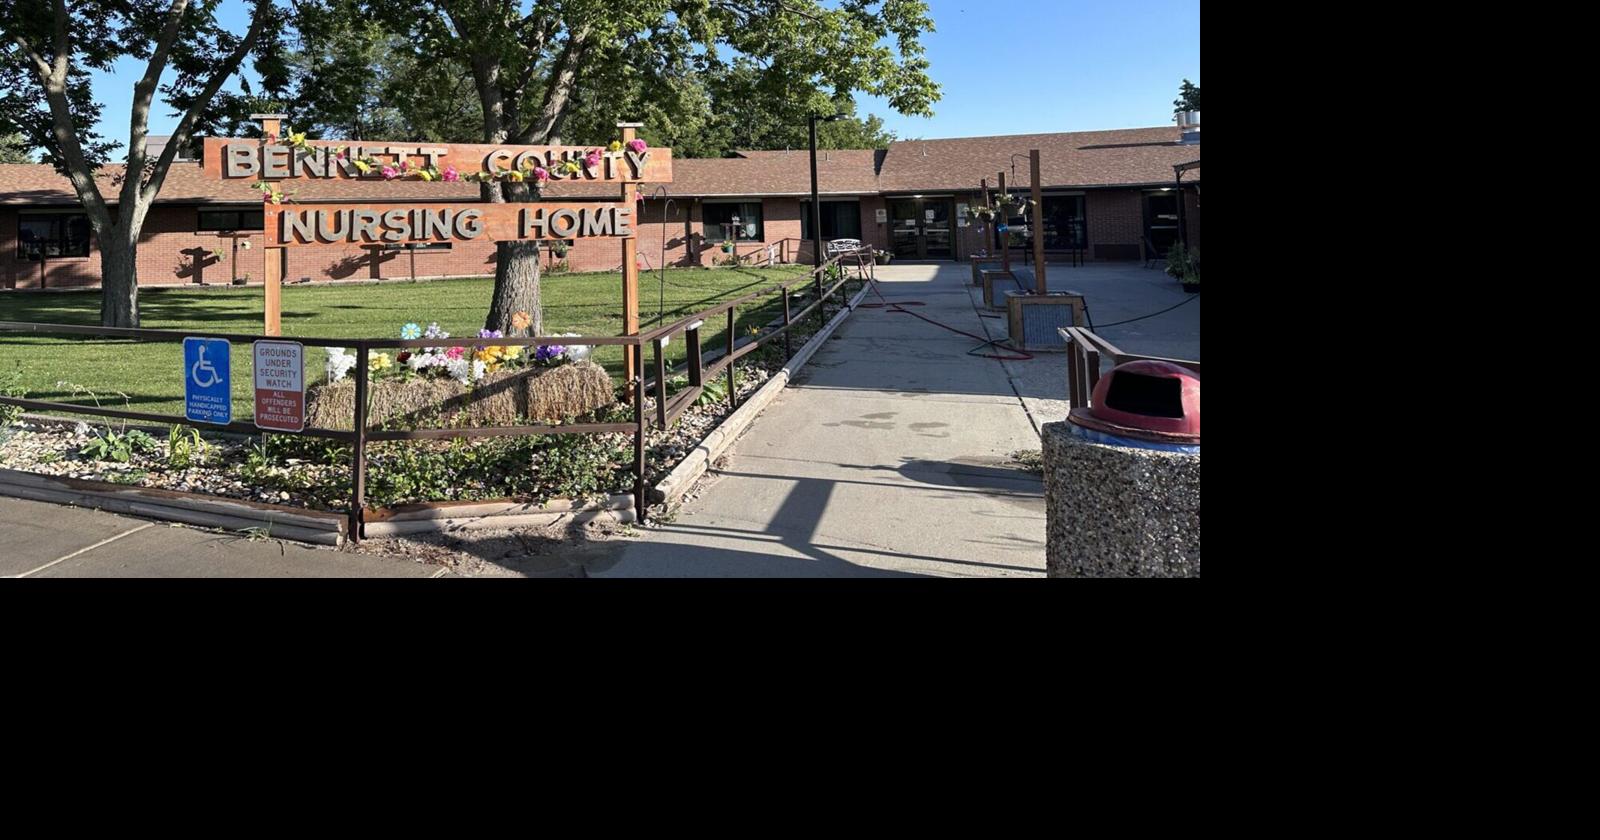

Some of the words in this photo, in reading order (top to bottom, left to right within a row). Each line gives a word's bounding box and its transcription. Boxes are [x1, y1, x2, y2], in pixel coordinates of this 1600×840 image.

[225, 144, 449, 180] BENNETT
[484, 149, 650, 180] COUNTY
[280, 207, 484, 242] NURSING
[520, 207, 632, 238] HOME
[260, 348, 297, 358] GROUNDS
[265, 359, 292, 368] UNDER
[260, 369, 297, 379] SECURITY
[266, 380, 292, 388] WATCH
[191, 394, 223, 403] PHYSICALLY
[261, 398, 297, 407] OFFENDERS
[189, 402, 227, 411] HANDICAPPED
[282, 407, 291, 415] BE
[188, 408, 212, 417] PARKING
[260, 413, 300, 424] PROSECUTED
